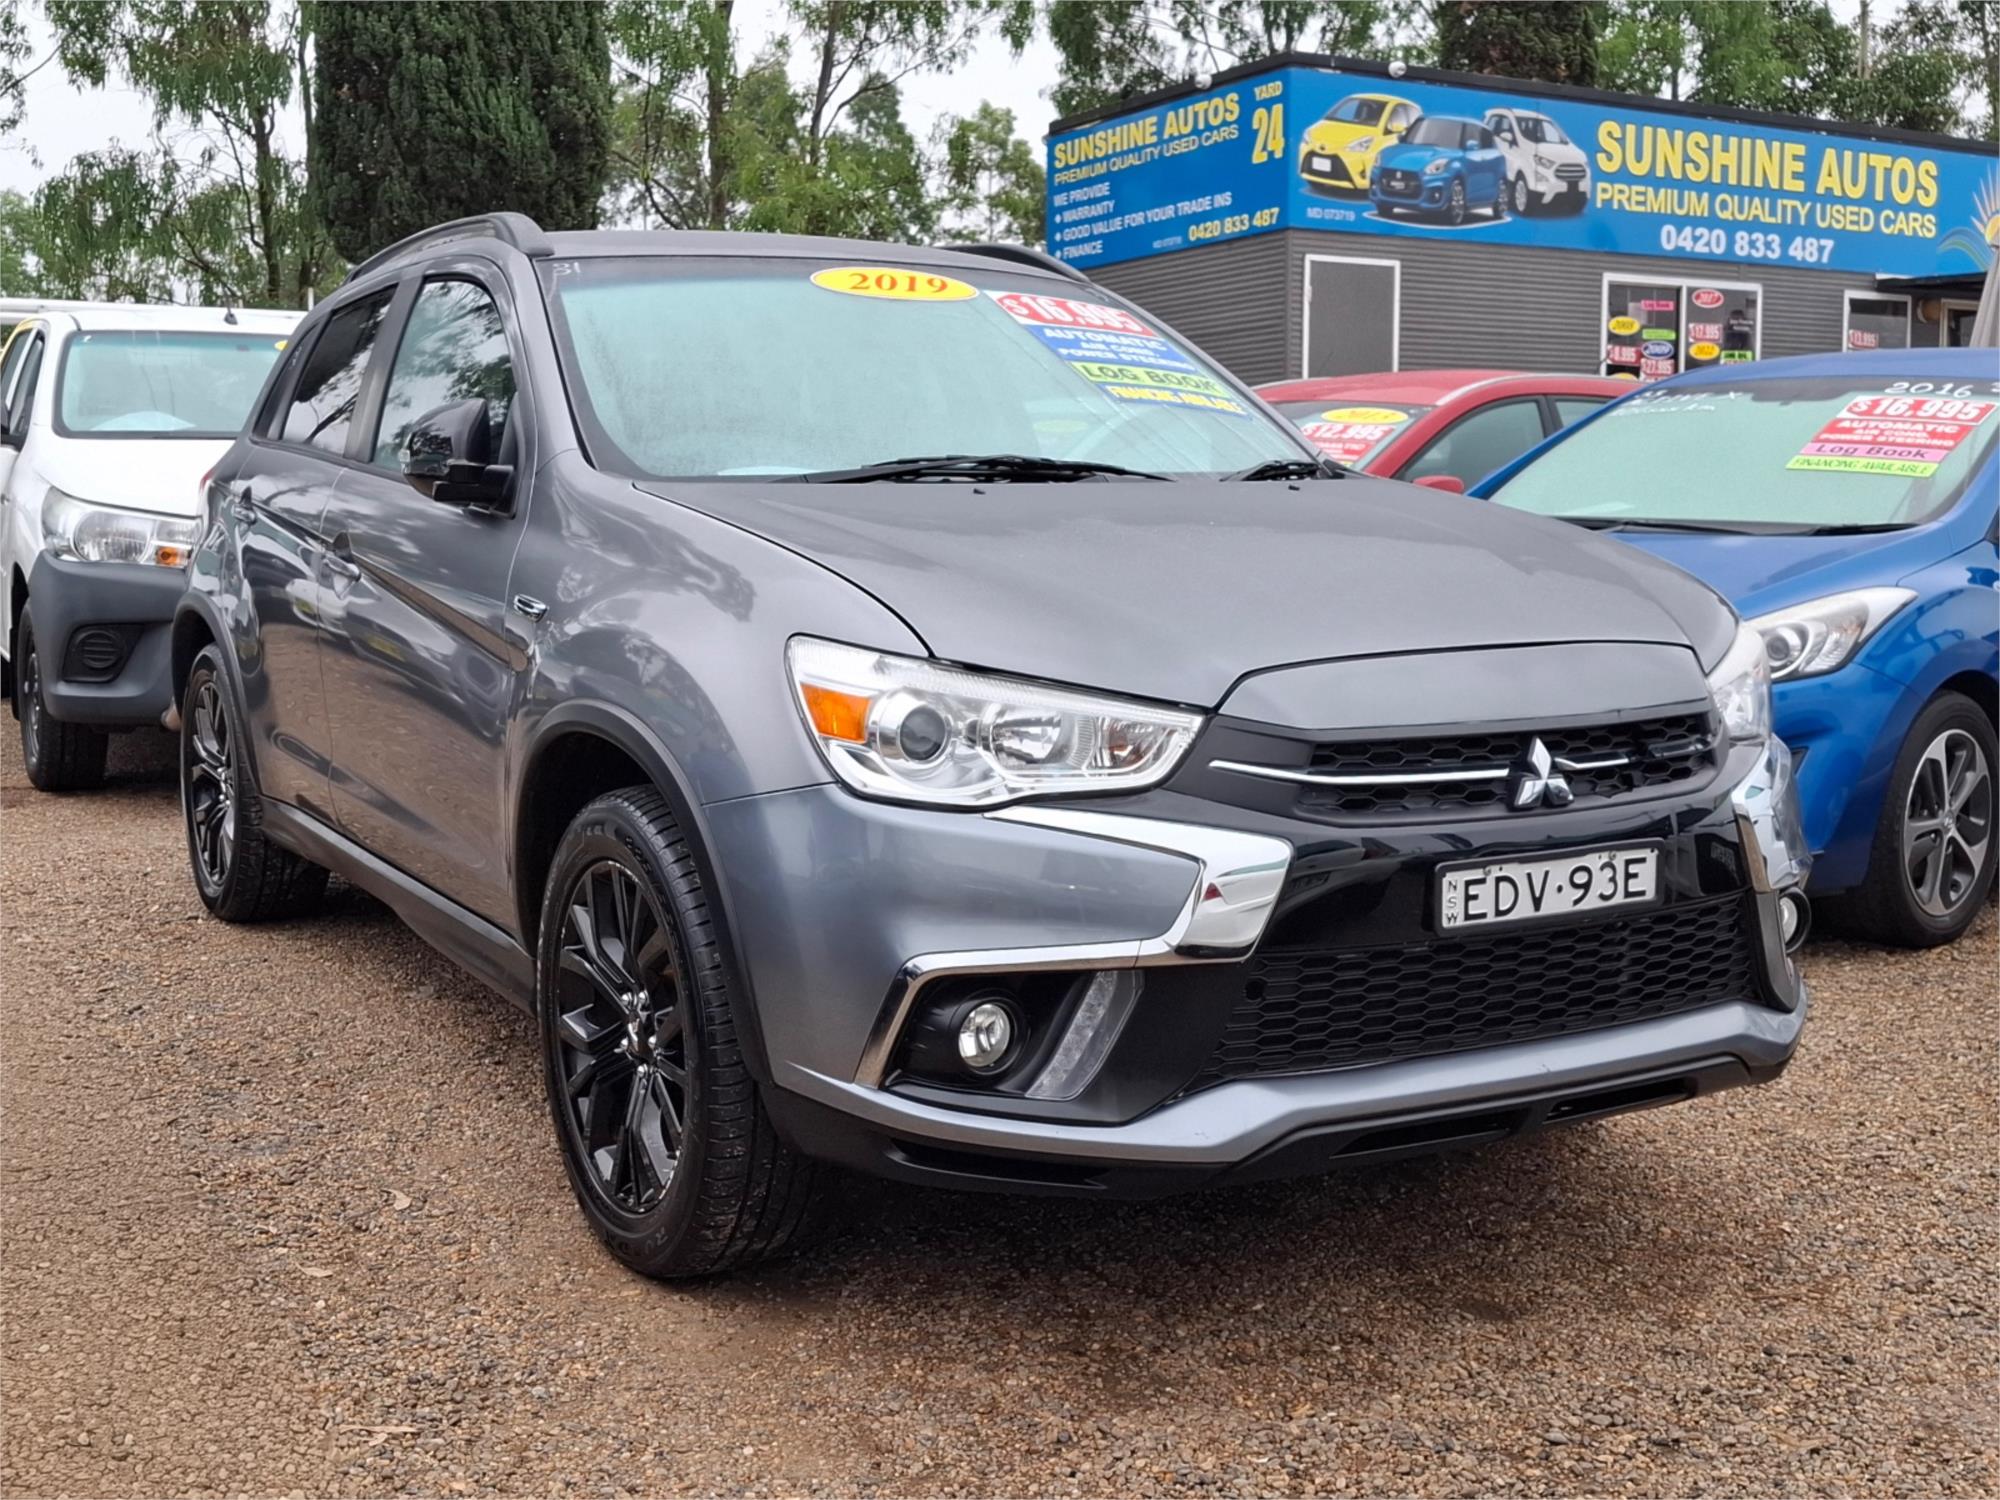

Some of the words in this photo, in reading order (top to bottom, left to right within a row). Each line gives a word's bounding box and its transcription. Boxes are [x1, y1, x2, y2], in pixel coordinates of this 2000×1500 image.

[1254, 81, 1283, 100] YARD
[1054, 116, 1158, 169] SUNSHINE
[1163, 93, 1240, 140] AUTOS
[1252, 103, 1284, 164] 24
[1054, 162, 1107, 186] PREMIUM
[1109, 148, 1161, 171] QUALITY
[1163, 135, 1199, 156] USED
[1200, 125, 1239, 146] CARS
[1596, 119, 1806, 193] SUNSHINE
[1815, 147, 1939, 208] AUTOS
[1054, 193, 1068, 207] WE
[1070, 182, 1110, 203] PROVIDE
[1062, 200, 1115, 223] WARRANTY
[1063, 224, 1091, 242] GOOD
[1091, 216, 1123, 235] VALUE
[1124, 212, 1145, 228] FOR
[1146, 206, 1175, 223] YOUR
[1176, 196, 1212, 216] TRADE
[1213, 191, 1233, 208] INS
[1595, 181, 1709, 218] PREMIUM
[1714, 192, 1812, 226] QUALITY
[1815, 203, 1874, 233] USED
[1878, 210, 1937, 239] CARS
[1187, 218, 1220, 242] 0420
[1224, 213, 1250, 235] 833
[1252, 206, 1280, 228] 487
[1062, 240, 1104, 260] FINANCE
[1660, 223, 1728, 255] 0420
[1733, 230, 1782, 260] 833
[1788, 236, 1835, 264] 487
[848, 271, 950, 294] 2019
[1001, 296, 1144, 333] $16,995
[1042, 328, 1168, 351] AUTOMATIC
[1056, 347, 1118, 360] POWER
[1081, 364, 1139, 382] LOG
[1145, 370, 1221, 395] BOOK
[1884, 381, 1974, 398] 2016
[1852, 397, 1986, 420] $16,995
[1836, 420, 1960, 434] AUTOMATIC
[1815, 444, 1858, 456] Log
[1866, 446, 1930, 459] Book
[1819, 433, 1875, 441] POWER
[1876, 435, 1955, 447] STEERING
[1794, 458, 1858, 469] FINANCING
[1860, 460, 1930, 474] AVAILABLE
[1447, 880, 1459, 924] NSW
